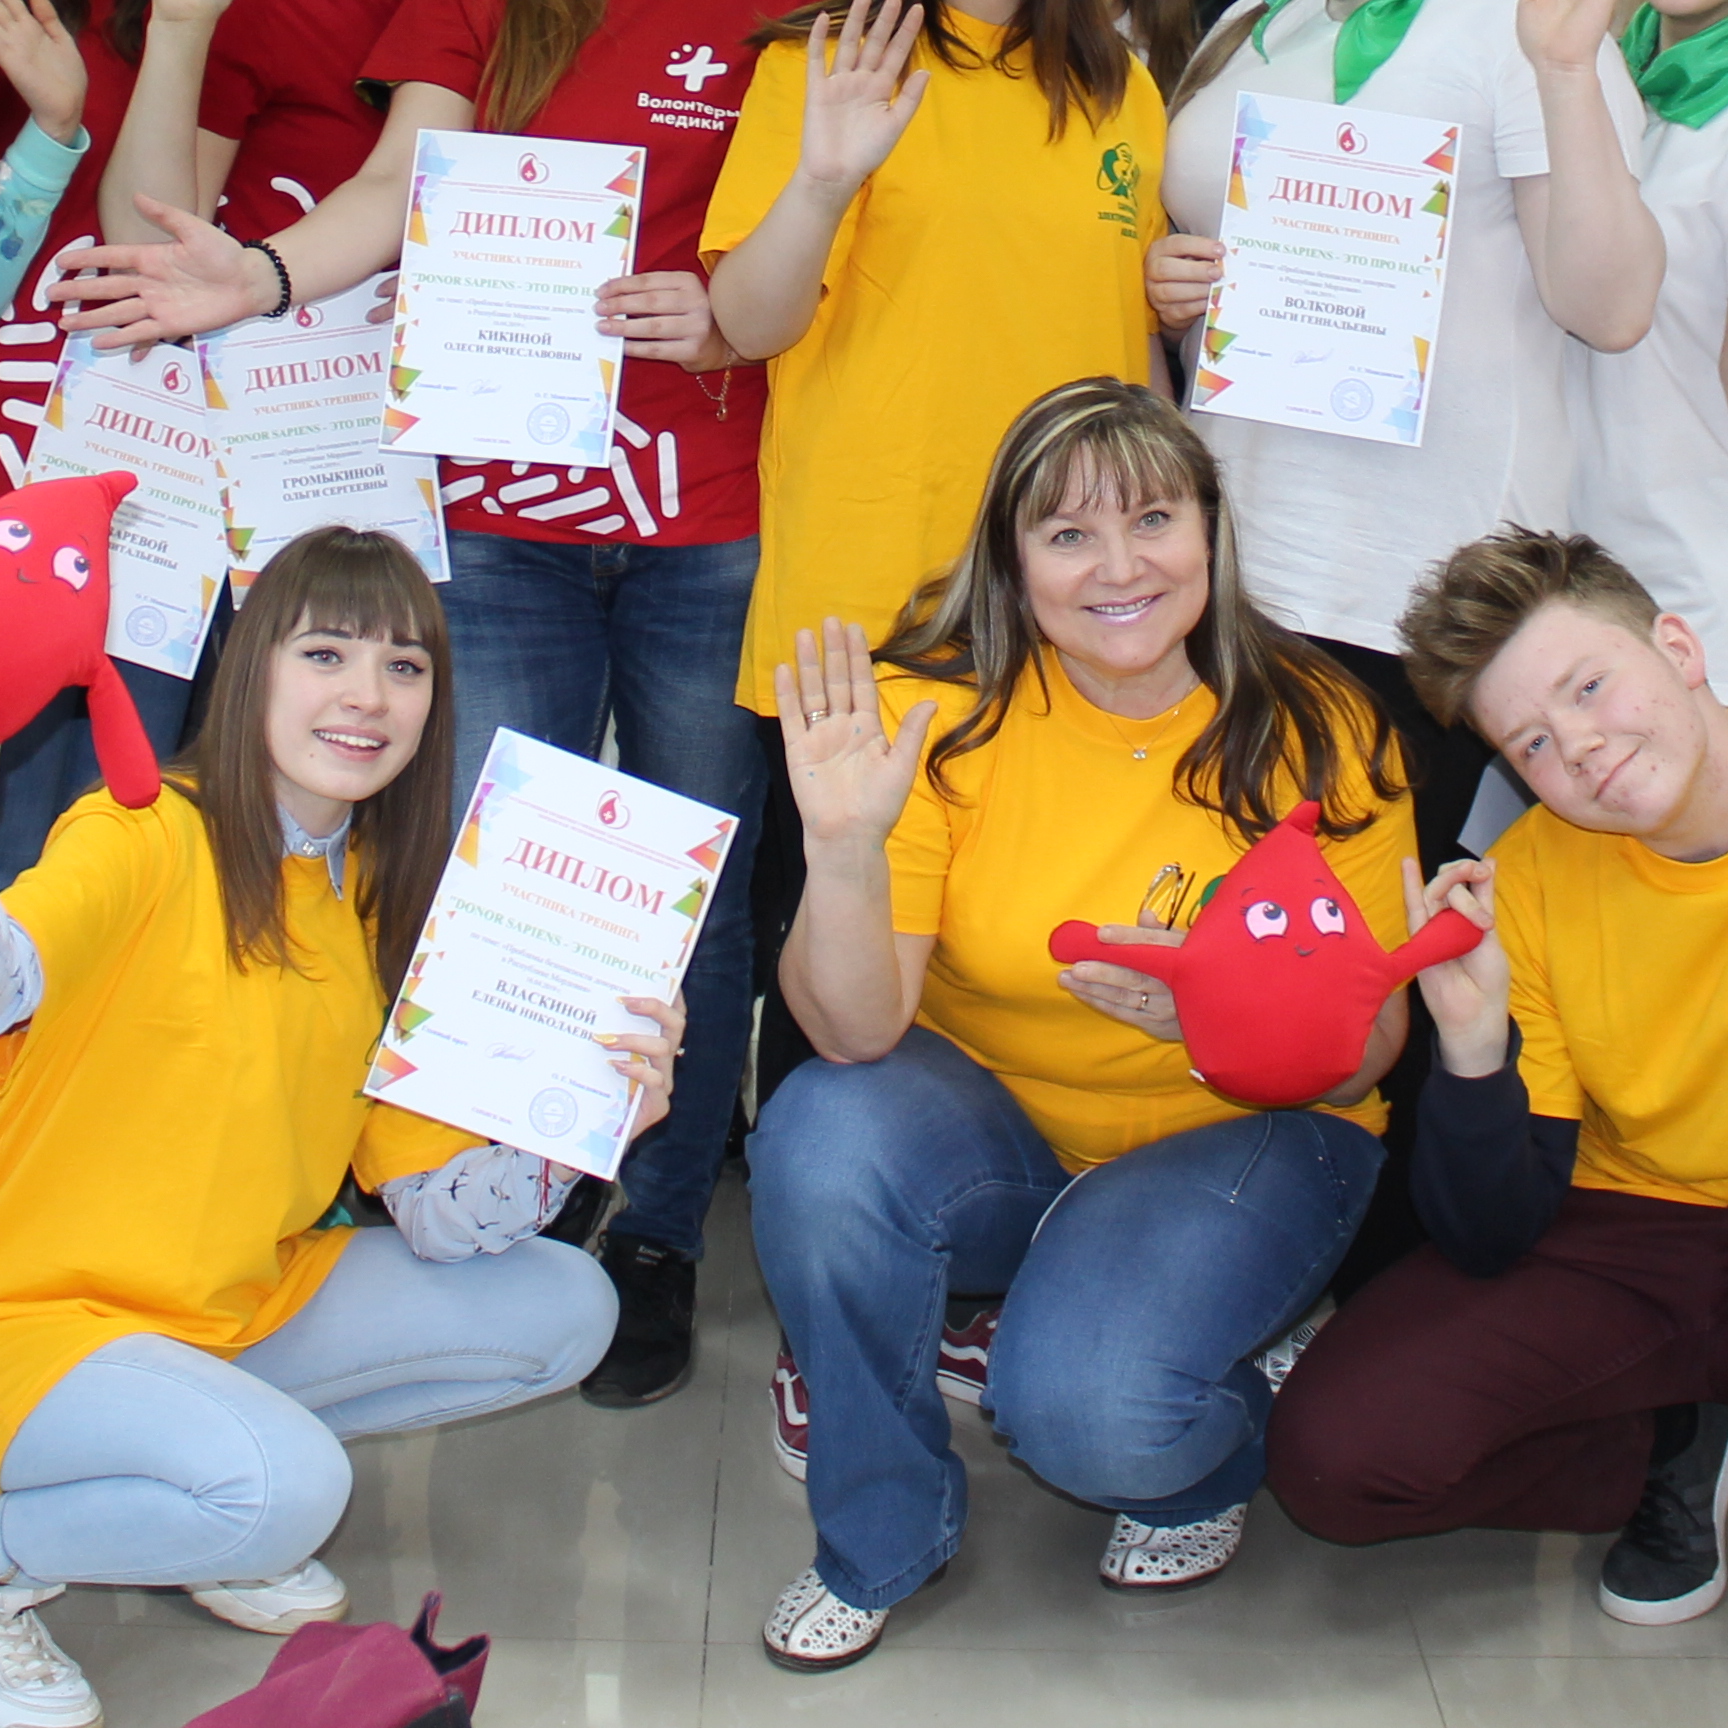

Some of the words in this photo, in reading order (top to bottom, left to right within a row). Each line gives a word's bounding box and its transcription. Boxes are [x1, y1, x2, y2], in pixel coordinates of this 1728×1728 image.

[650, 110, 725, 132] медики
[1270, 176, 1413, 219] ДИПЛОМ
[449, 211, 595, 244] ДИПЛОМ
[1272, 216, 1338, 234] УЧАСТНИКА
[452, 250, 521, 264] УЧАСТНИКА
[524, 256, 582, 269] ТРЕНИНГА
[1283, 244, 1332, 260] SAPIENS
[463, 277, 515, 290] SAPIENS
[525, 282, 548, 293] ЭТО
[551, 284, 574, 295] ПРО
[1285, 293, 1365, 319] ВОЛКОВОЙ
[1258, 307, 1298, 322] ОЛЬГИ
[1301, 314, 1385, 336] ГЕННАДЬЕВНЫ
[479, 328, 551, 344] КИКИНОЙ
[444, 341, 483, 353] ОЛЕСИ
[486, 345, 582, 361] ВЯЧЕСЛАВОВНЫ
[243, 353, 383, 394] ДИПЛОМ
[254, 399, 319, 415] УЧАСТНИКА
[85, 403, 216, 459] ДИПЛОМ
[272, 423, 320, 439] SAPIENS
[83, 440, 148, 467] УЧАСТНИКА
[282, 464, 384, 488] ГРОМЫКИНОЙ
[282, 489, 321, 502] ОЛЬГИ
[323, 480, 387, 495] СЕРГЕЕВНЫ
[197, 503, 222, 518] НАС
[504, 837, 666, 915] ДИПЛОМ
[500, 883, 576, 918] УЧАСТНИКА
[578, 912, 641, 942] ТРЕНИНГА
[505, 918, 561, 946] SAPIENS
[571, 943, 598, 960] ЭТО
[601, 954, 628, 971] ПРО
[495, 976, 597, 1025] ВЛАСКИНОЙ
[471, 989, 517, 1013] ЕЛЕНЫ
[519, 1007, 595, 1042] НИКОЛАЕВ
